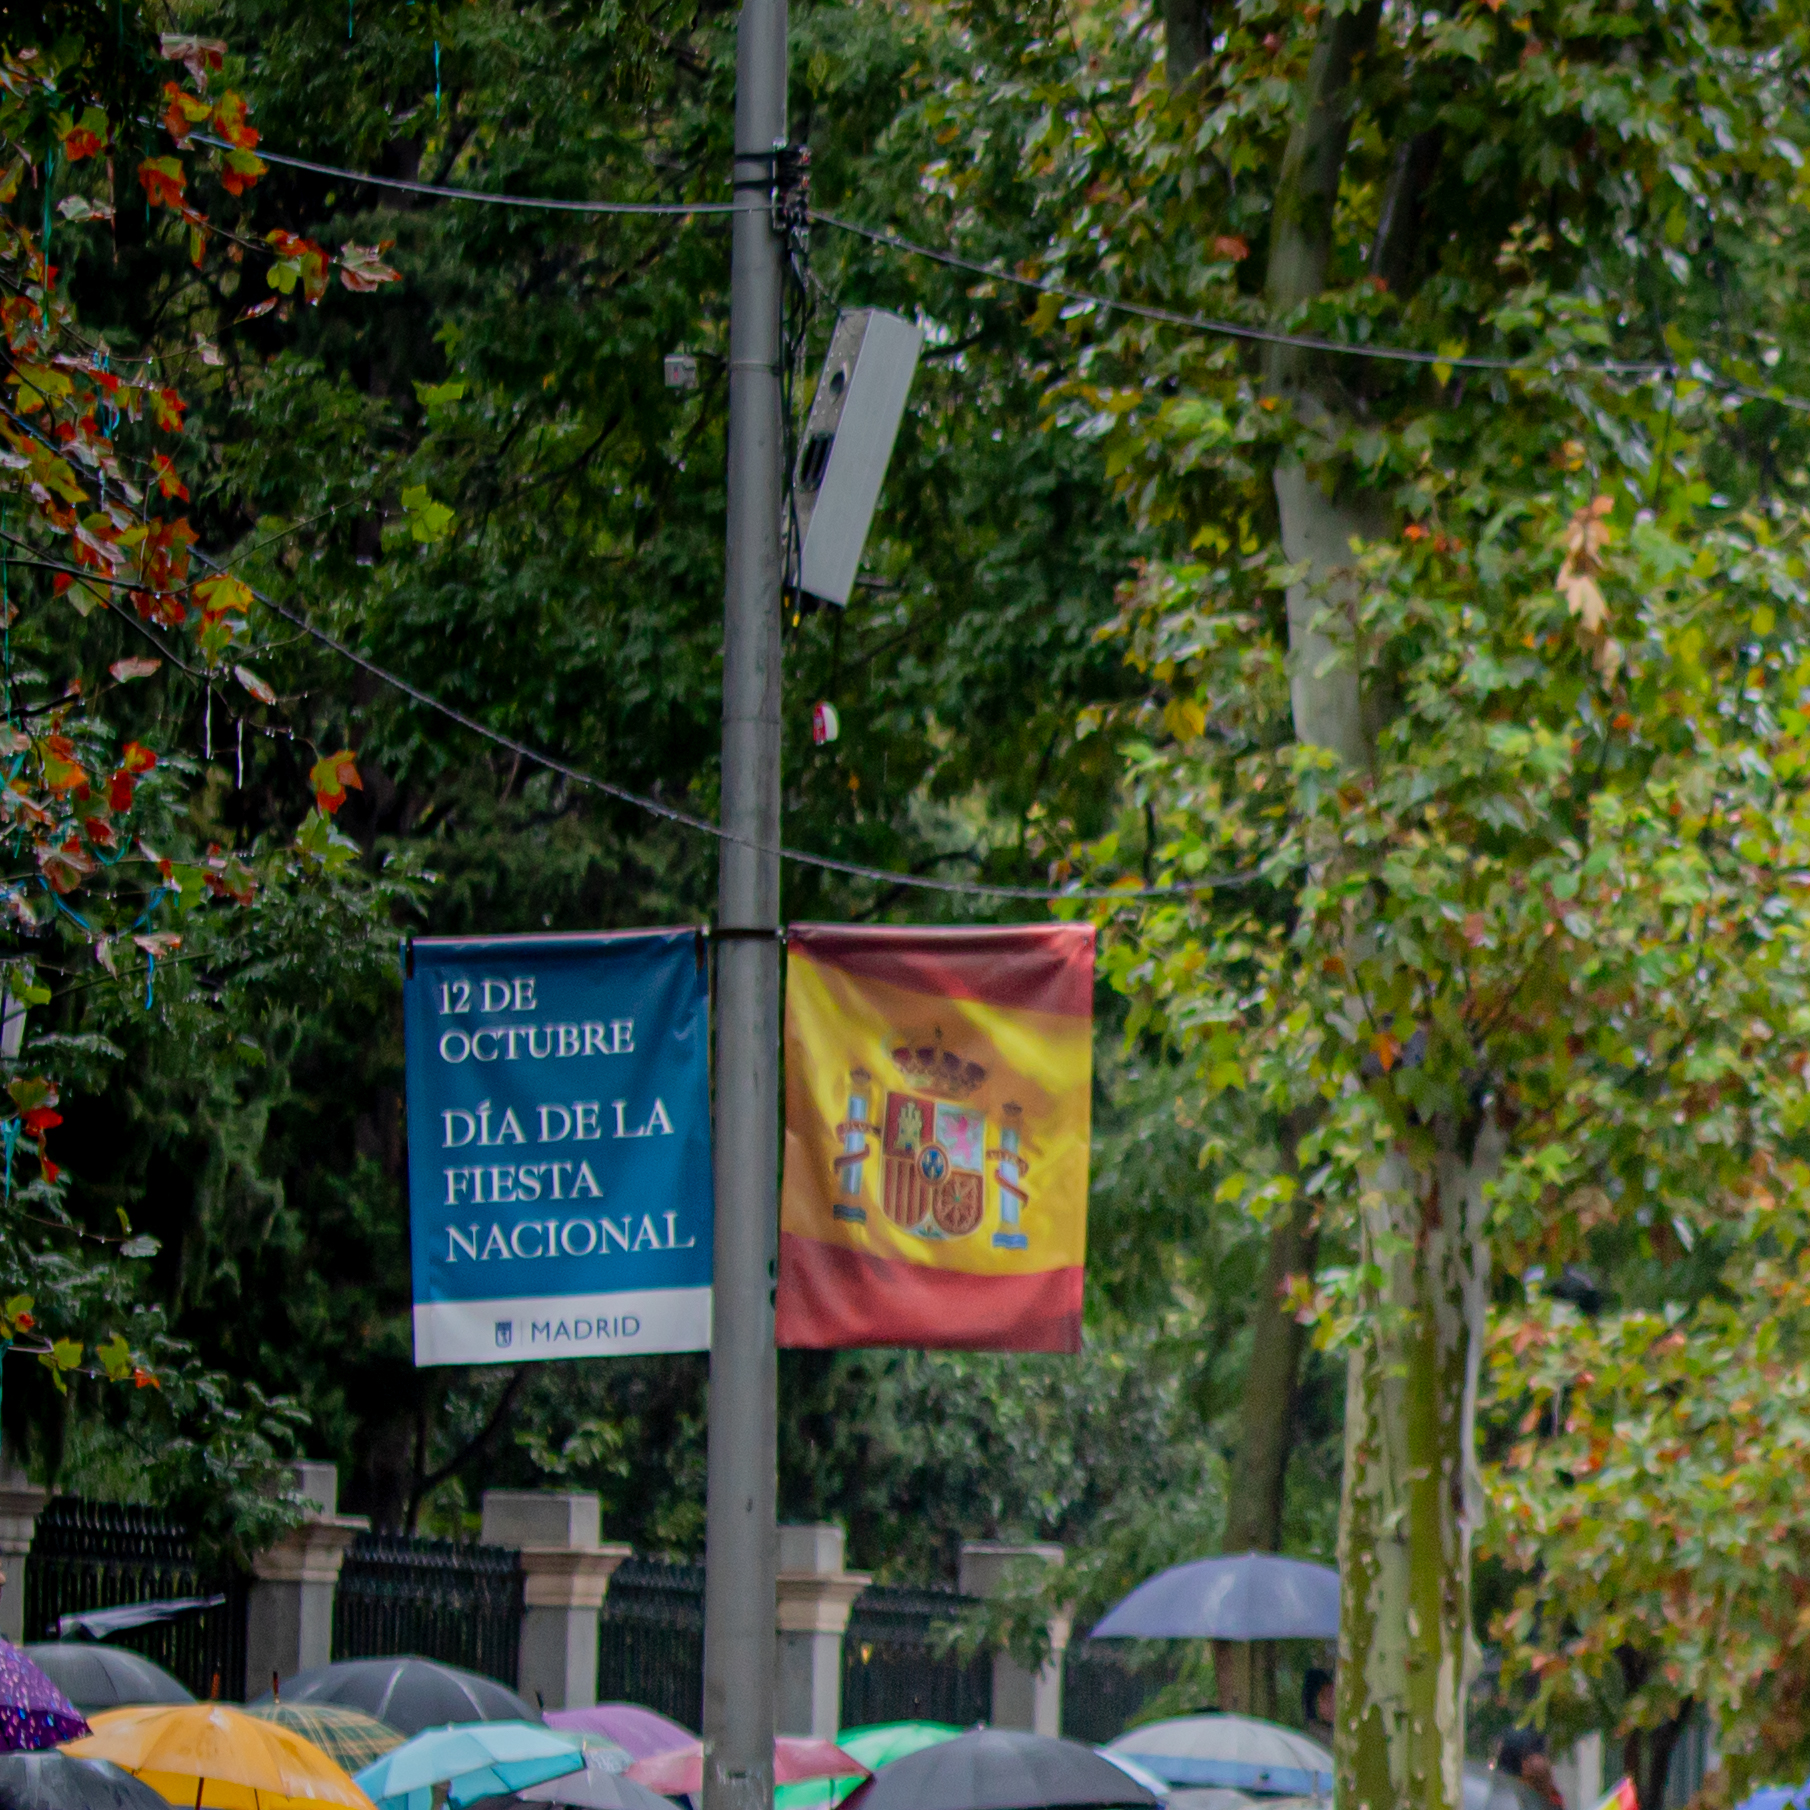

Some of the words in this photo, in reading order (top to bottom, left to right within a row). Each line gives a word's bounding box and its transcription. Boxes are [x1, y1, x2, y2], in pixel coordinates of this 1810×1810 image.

[439, 978, 471, 1015] 12
[480, 977, 537, 1013] DE
[438, 1019, 634, 1064] OCTUBRE
[441, 1098, 527, 1148] DÍA
[536, 1100, 601, 1143] DE
[611, 1098, 674, 1138] LA
[443, 1160, 603, 1205] FIESTA
[445, 1211, 695, 1263] NACIONAL
[530, 1316, 640, 1343] MADRID
